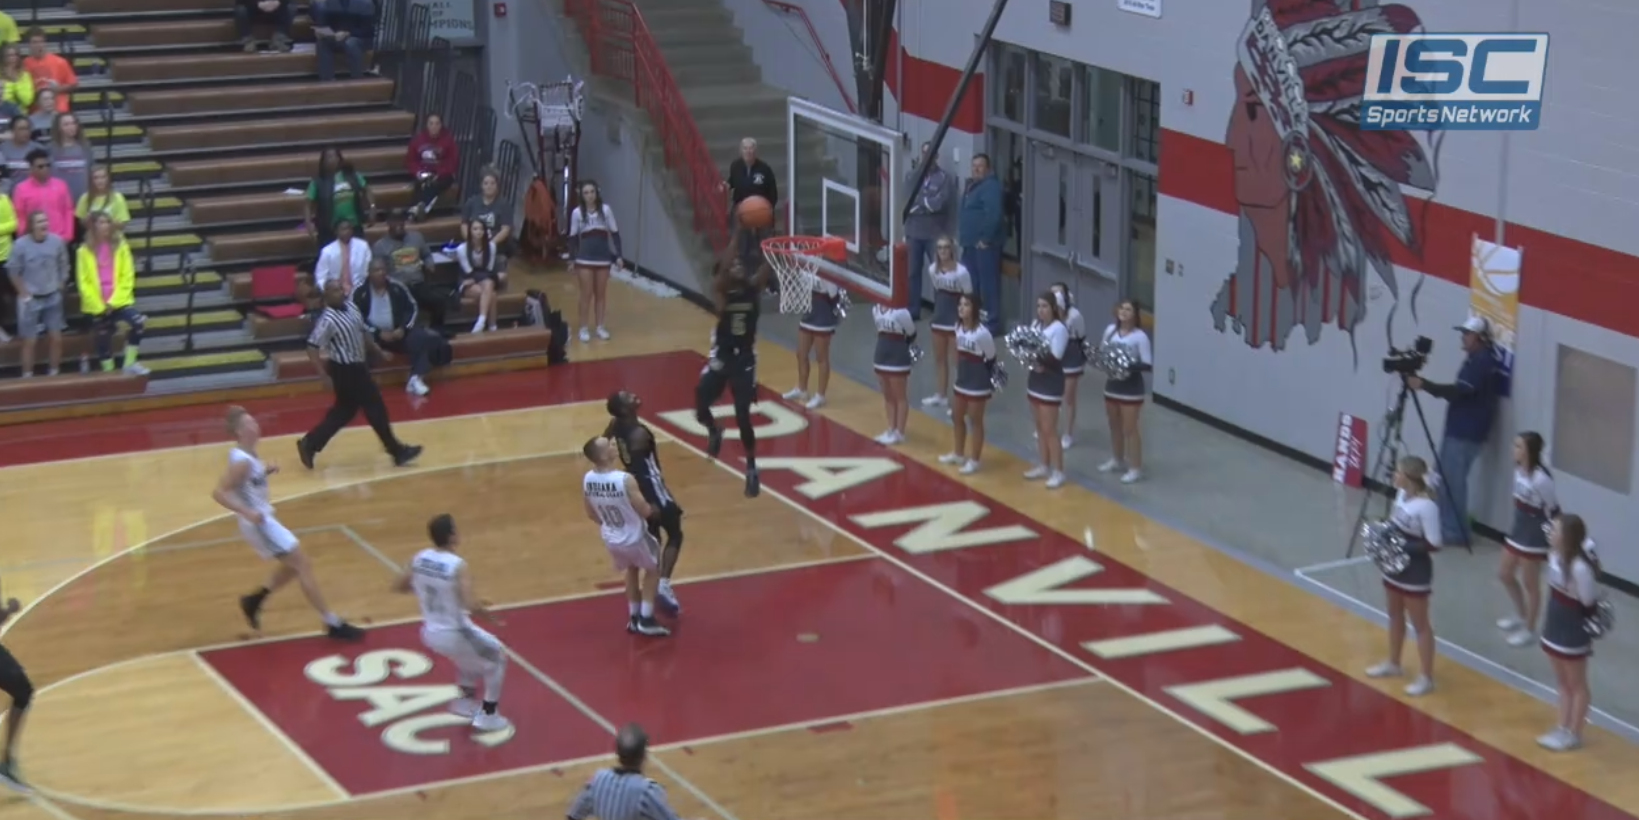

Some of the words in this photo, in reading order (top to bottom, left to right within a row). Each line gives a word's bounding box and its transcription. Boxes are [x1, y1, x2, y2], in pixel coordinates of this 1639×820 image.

[1332, 414, 1353, 483] HANDS
[598, 504, 625, 529] 10
[303, 648, 515, 754] SAC
